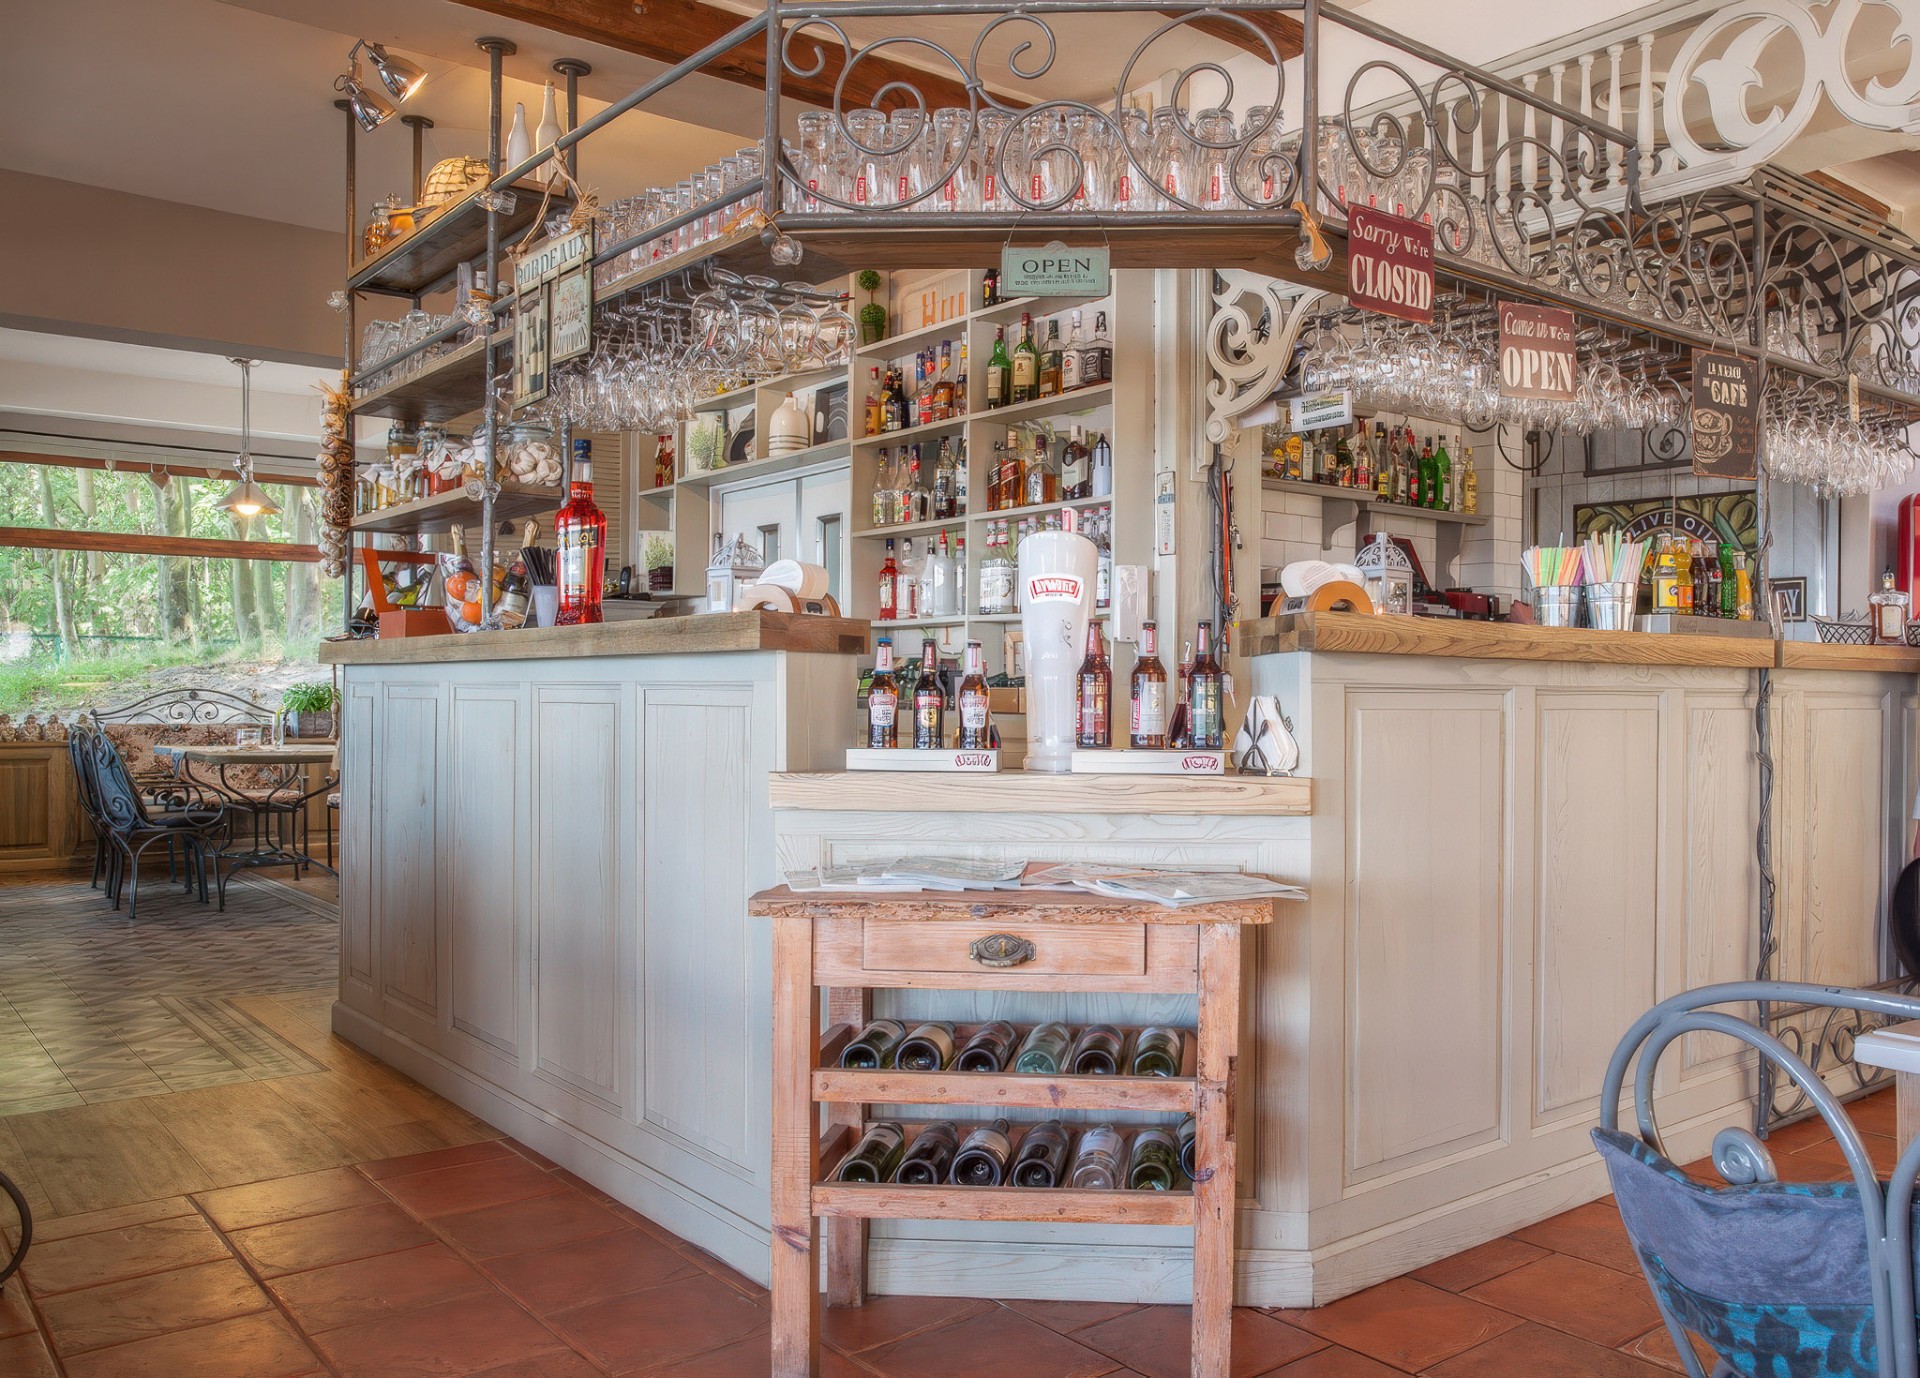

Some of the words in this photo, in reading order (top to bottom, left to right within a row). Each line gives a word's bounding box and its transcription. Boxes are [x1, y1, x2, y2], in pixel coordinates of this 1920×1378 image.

[1353, 215, 1402, 254] Sorry
[516, 234, 588, 284] BORDEAUX
[1022, 258, 1091, 273] OPEN
[1351, 253, 1432, 311] CLOSED
[1504, 311, 1534, 338] Come
[1536, 314, 1549, 339] in
[1503, 346, 1574, 393] OPEN
[1711, 379, 1748, 408] CAFÉ
